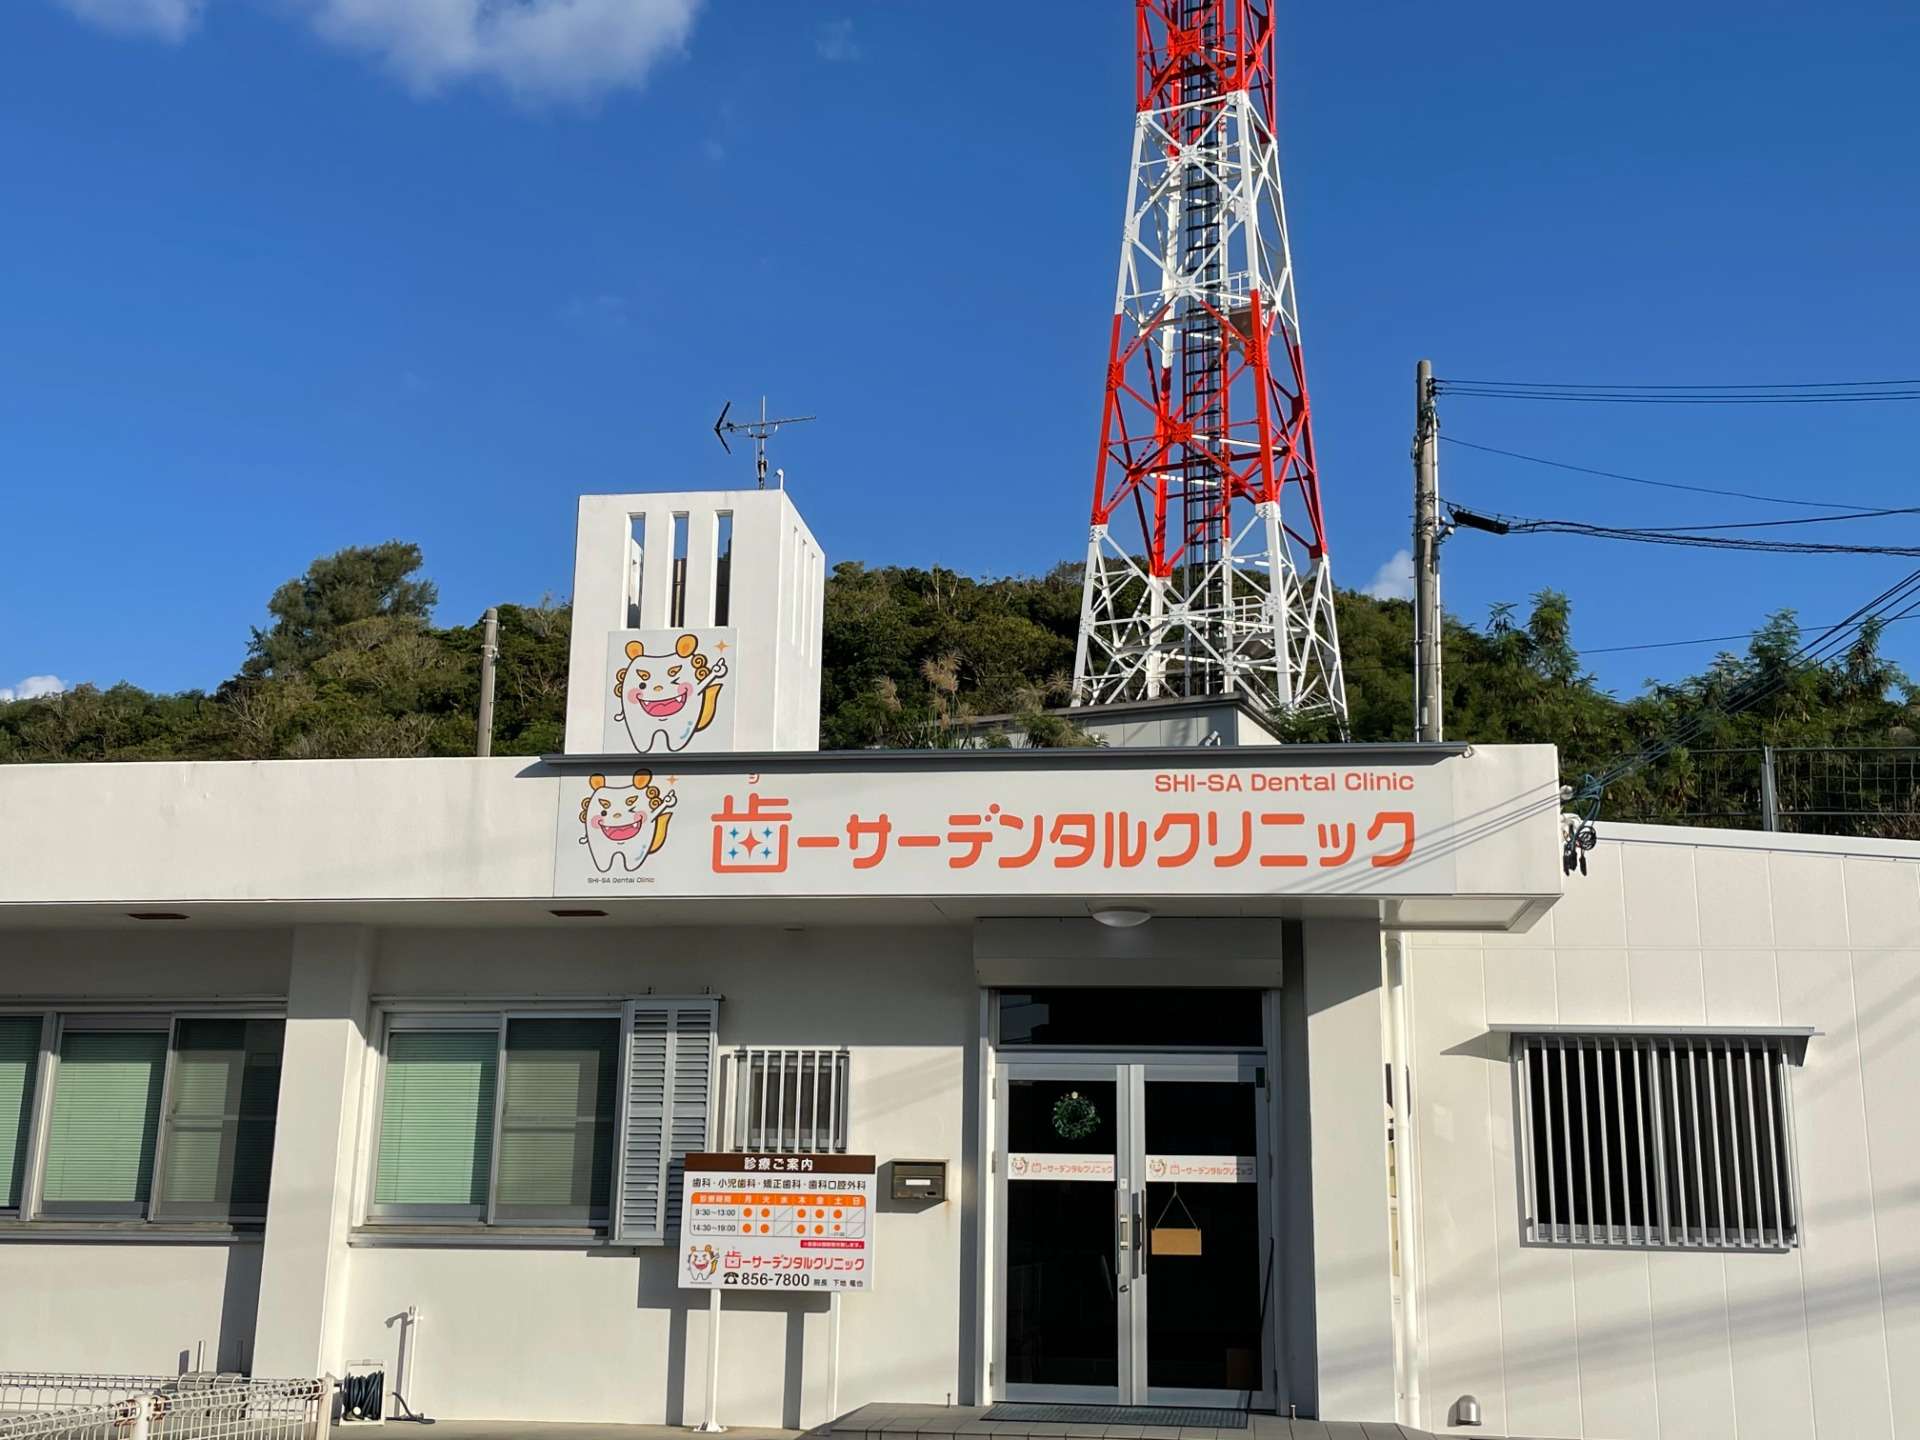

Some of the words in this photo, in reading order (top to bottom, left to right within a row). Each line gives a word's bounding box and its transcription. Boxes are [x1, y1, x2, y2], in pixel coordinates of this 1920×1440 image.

[1154, 773, 1242, 792] SHI-SA
[1251, 773, 1336, 791] Dental
[1344, 772, 1414, 791] Clinic
[711, 793, 1415, 873] 歯ーサーデンタルクリニック
[744, 1157, 814, 1171] 診療ご案内
[741, 1273, 810, 1286] 856-7800
